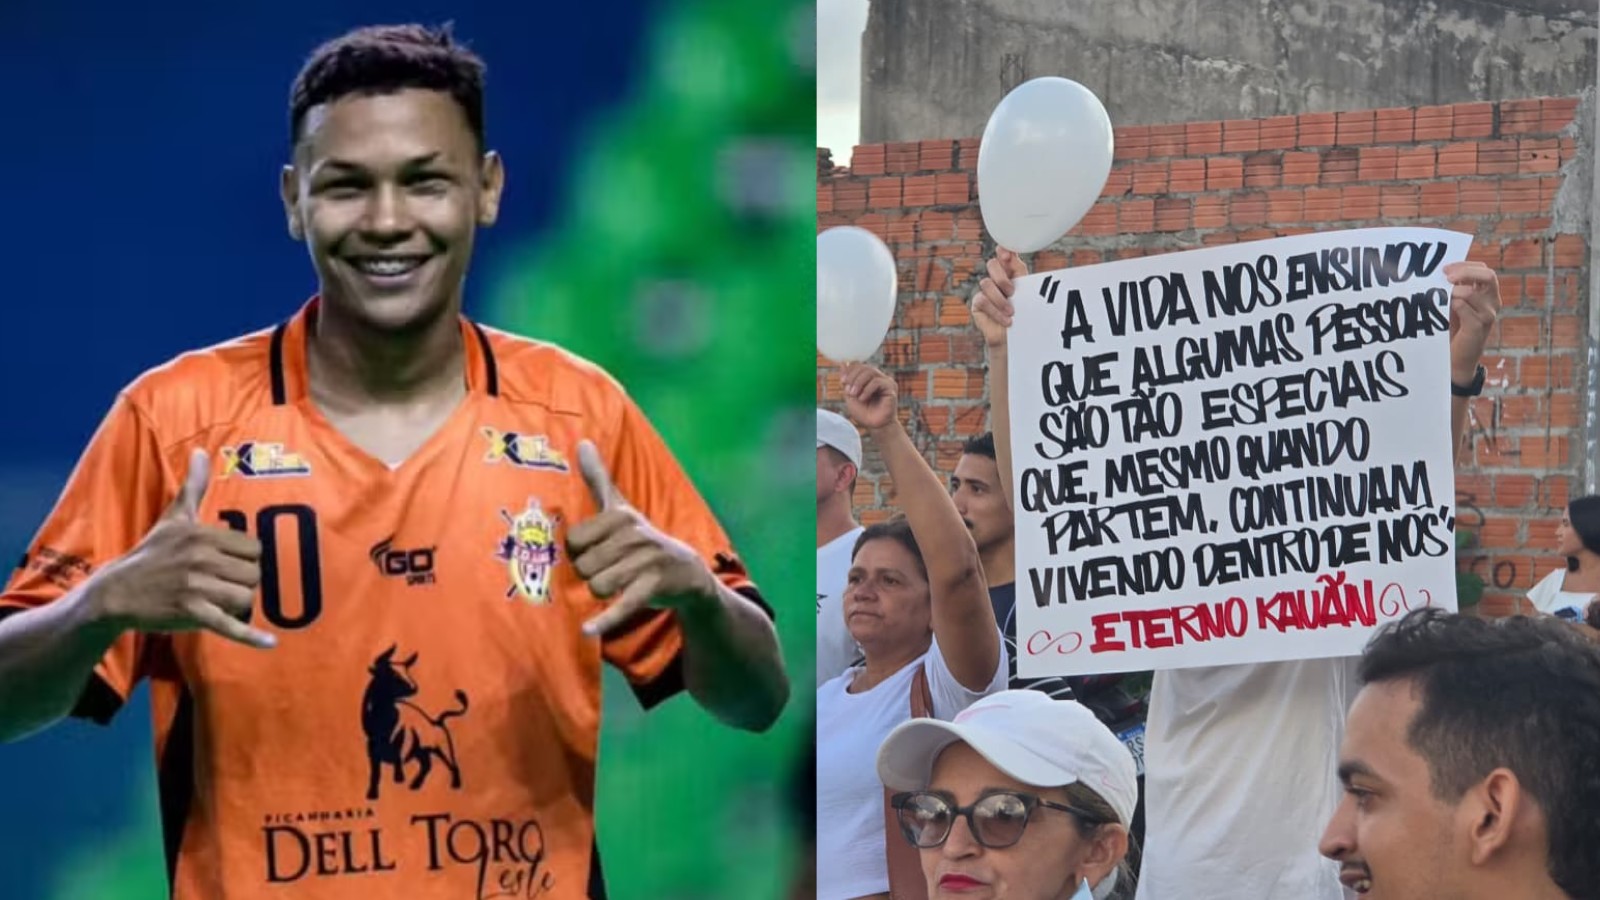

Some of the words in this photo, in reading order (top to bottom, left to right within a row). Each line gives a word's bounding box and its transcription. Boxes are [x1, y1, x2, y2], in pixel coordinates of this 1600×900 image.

[1102, 272, 1200, 336] VIDA
[1202, 254, 1282, 318] NOS
[1286, 241, 1448, 302] ENSINOU
[1041, 352, 1120, 407] QUE
[1132, 313, 1303, 389] ALGUMAS
[1305, 288, 1449, 355] PESSOAS
[1035, 401, 1109, 460] SÃO
[1111, 388, 1182, 443] TÃO
[1201, 350, 1409, 431] ESPECIAIS
[1104, 436, 1230, 498] MESMO
[1236, 417, 1370, 480] QUANDO
[1229, 460, 1434, 533] CONTINUAM
[385, 548, 433, 575] GO
[1028, 546, 1185, 607] VIVENDO
[1193, 528, 1320, 587] DENTRO
[1320, 522, 1371, 567] DE
[1090, 597, 1248, 653] ETERNO
[1256, 571, 1377, 633] KAUÃN
